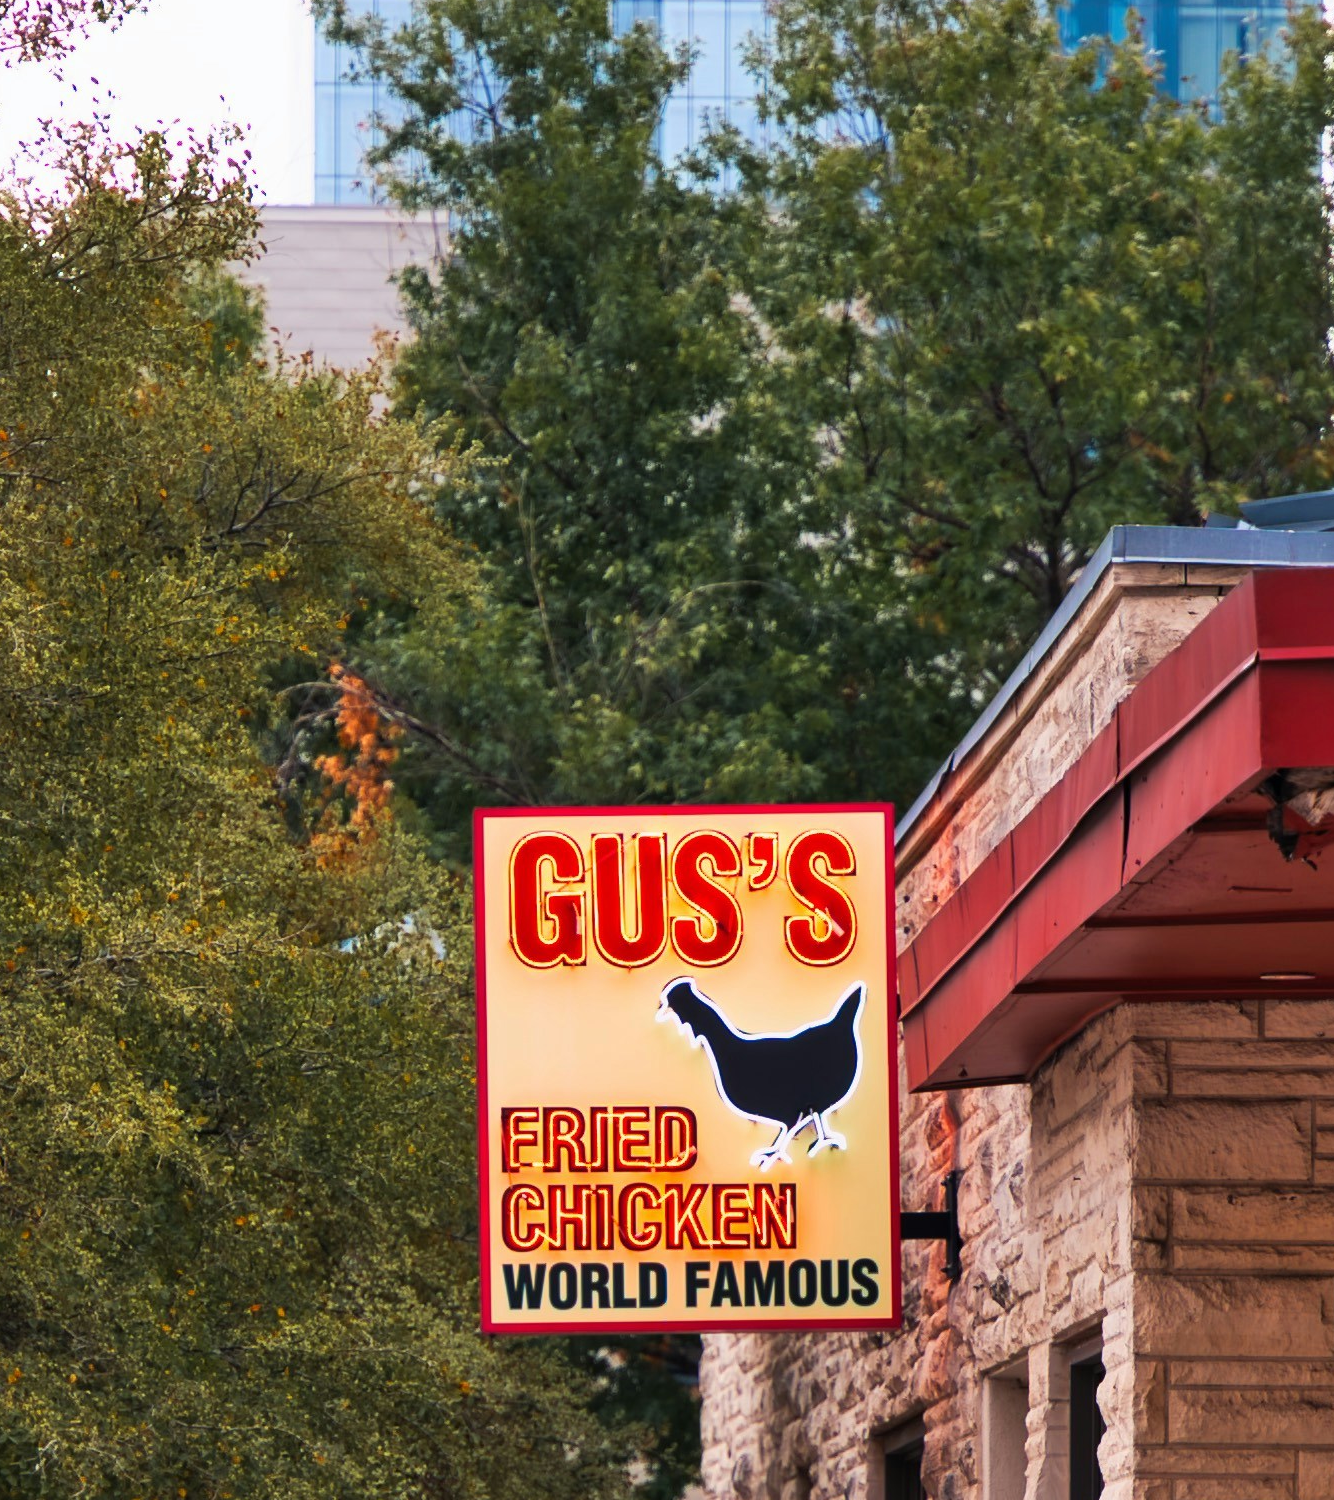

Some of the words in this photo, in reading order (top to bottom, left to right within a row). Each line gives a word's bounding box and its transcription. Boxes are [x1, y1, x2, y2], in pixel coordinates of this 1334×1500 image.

[508, 829, 858, 968] GUS'S
[501, 1106, 698, 1173] FRIED
[501, 1182, 797, 1253] CHICKEN
[502, 1262, 668, 1310] WORLD
[685, 1257, 880, 1308] FAMOUS
